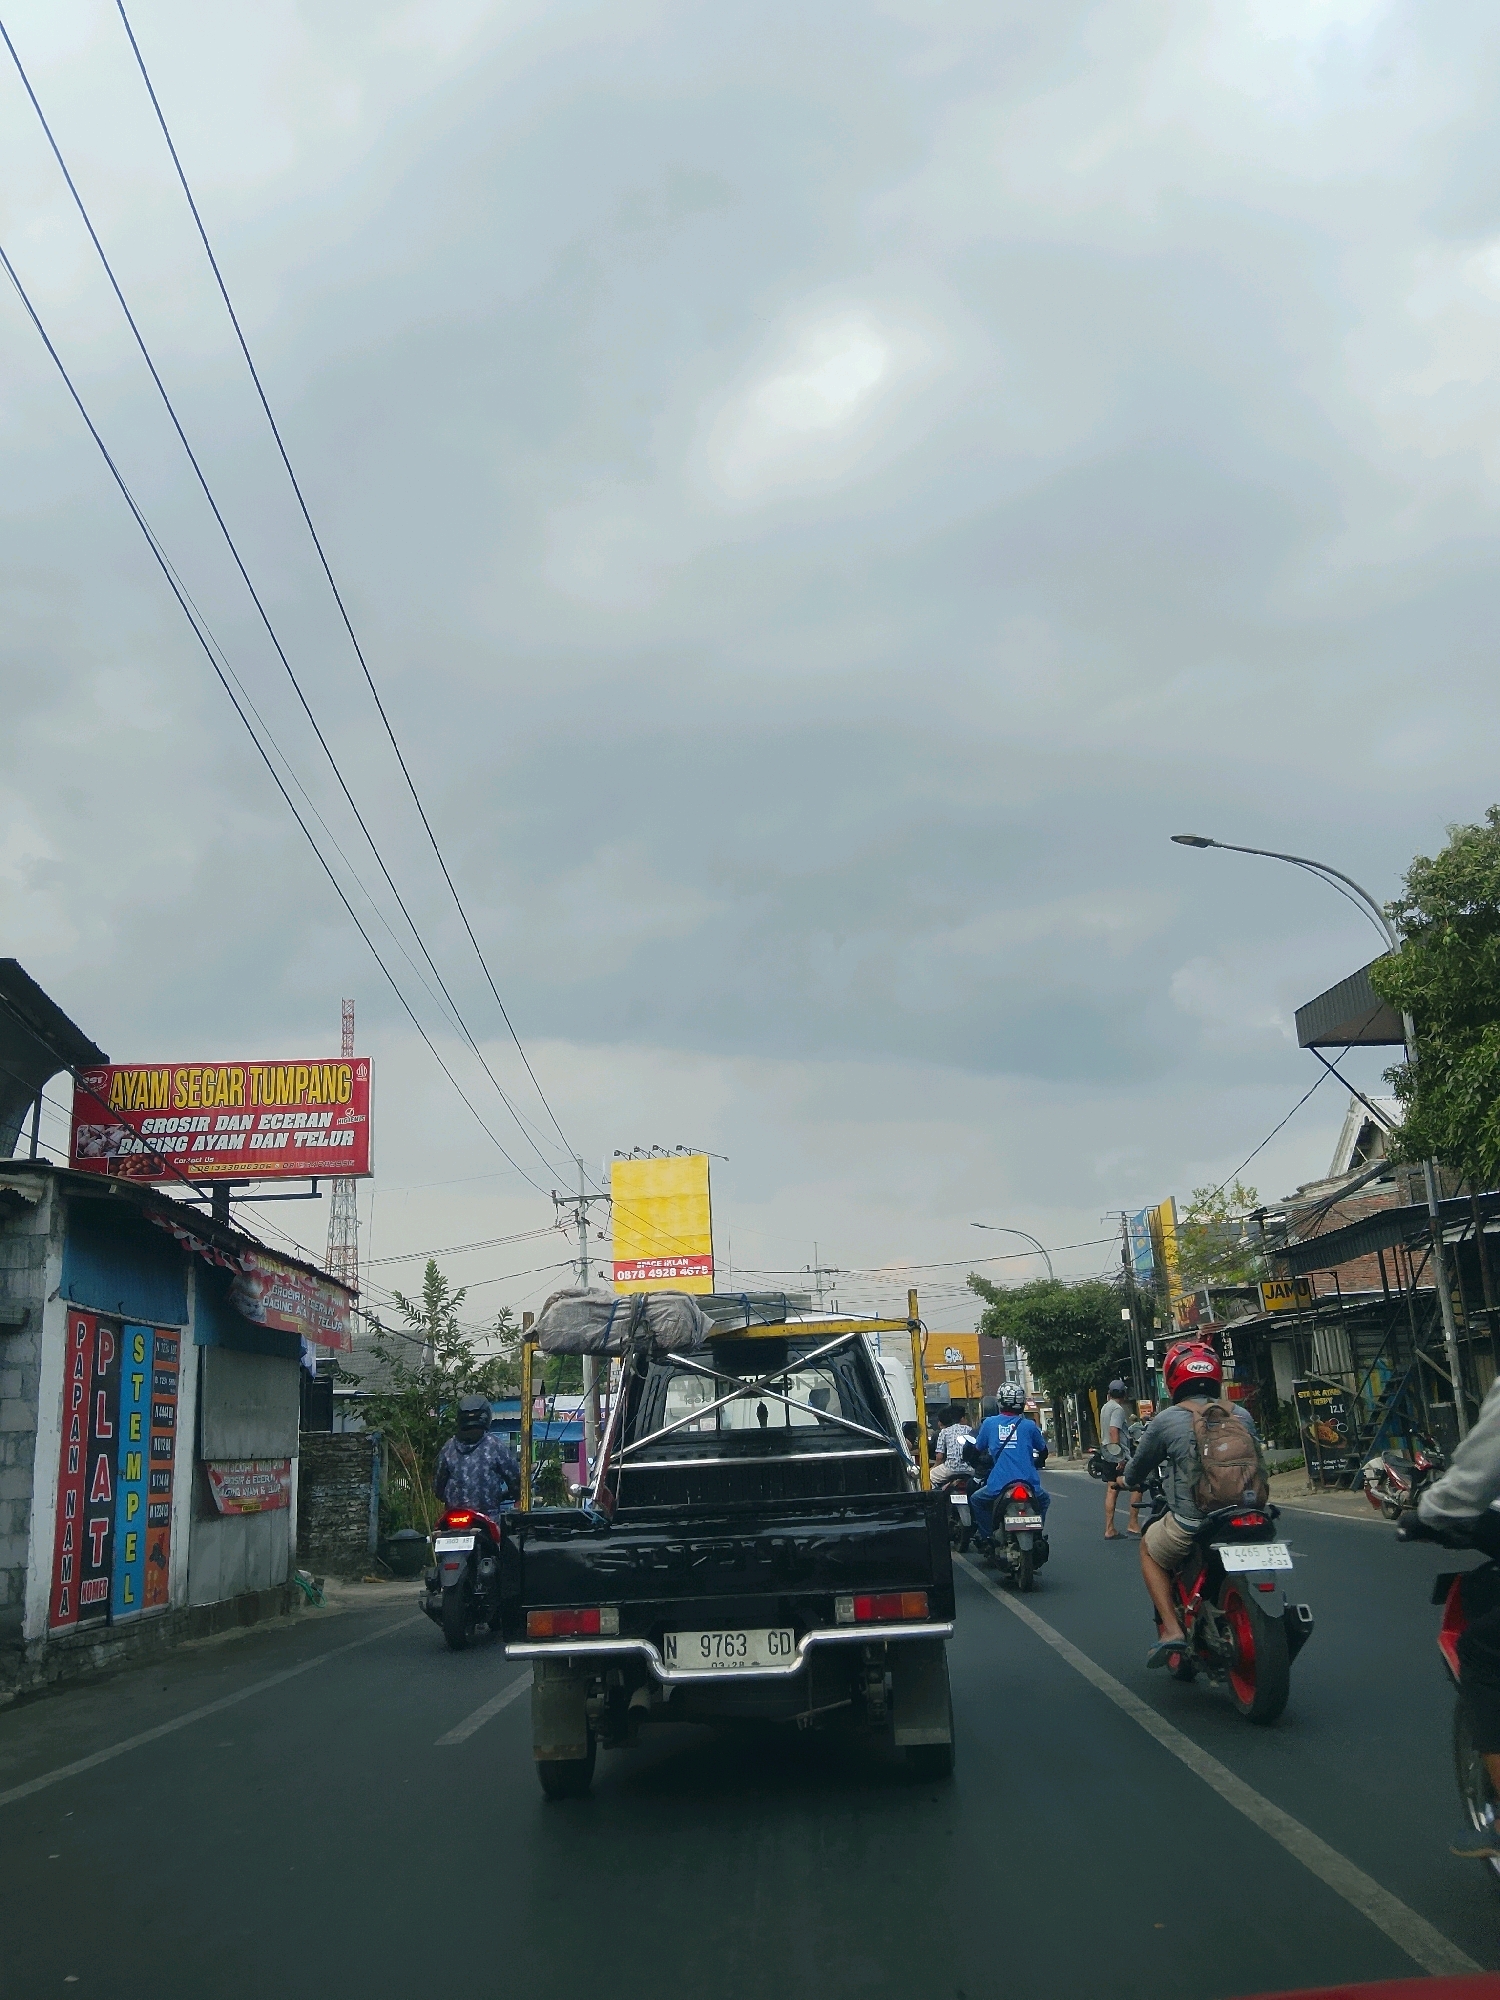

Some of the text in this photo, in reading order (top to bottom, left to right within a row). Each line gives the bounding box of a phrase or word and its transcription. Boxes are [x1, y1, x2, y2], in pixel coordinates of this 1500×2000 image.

[109, 1064, 353, 1111] AYAM SEGAR TUMPANG
[141, 1112, 334, 1135] GROSIR DAN ECERAN
[118, 1130, 355, 1154] DAGING AYAM DAN TELUR
[664, 1258, 689, 1266] IKLAN
[617, 1270, 646, 1280] 0878
[1265, 1282, 1308, 1299] JAMU
[262, 1294, 293, 1313] DAGING
[319, 1316, 344, 1332] TELUR
[87, 1329, 116, 1569] PLAT
[58, 1320, 88, 1619] PAPAN NAMA
[123, 1333, 146, 1606] STEMPEL
[1222, 1549, 1230, 1557] N
[665, 1633, 791, 1660] N 9763 GD
